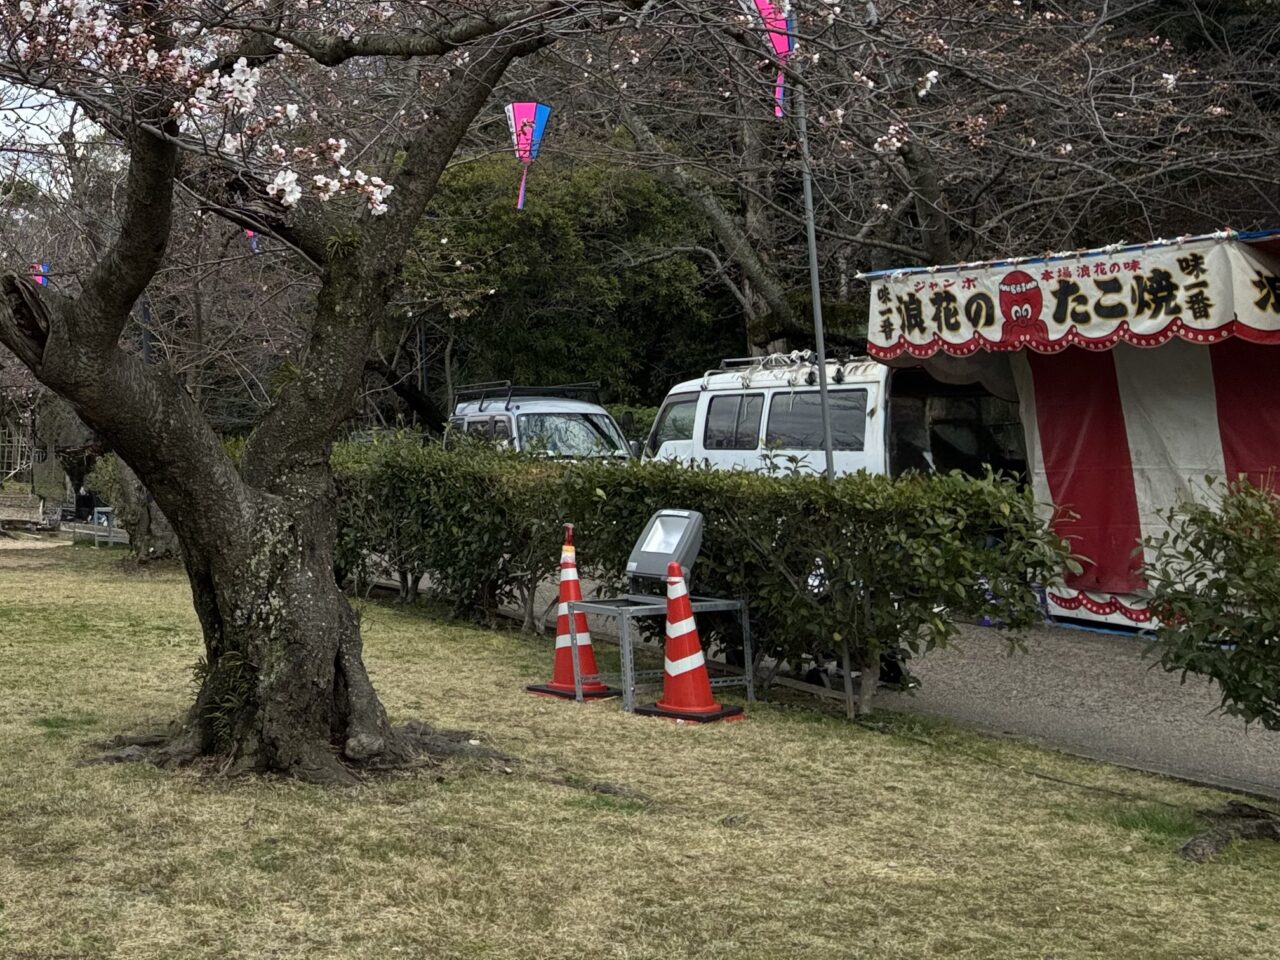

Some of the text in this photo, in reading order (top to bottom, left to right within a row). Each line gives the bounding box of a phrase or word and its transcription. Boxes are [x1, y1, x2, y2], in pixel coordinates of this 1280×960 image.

[895, 267, 1182, 336] 浪花の たこ焼
[1041, 259, 1142, 282] 本場浪花の味
[1176, 252, 1215, 321] 味一番
[877, 284, 895, 341] 味一番
